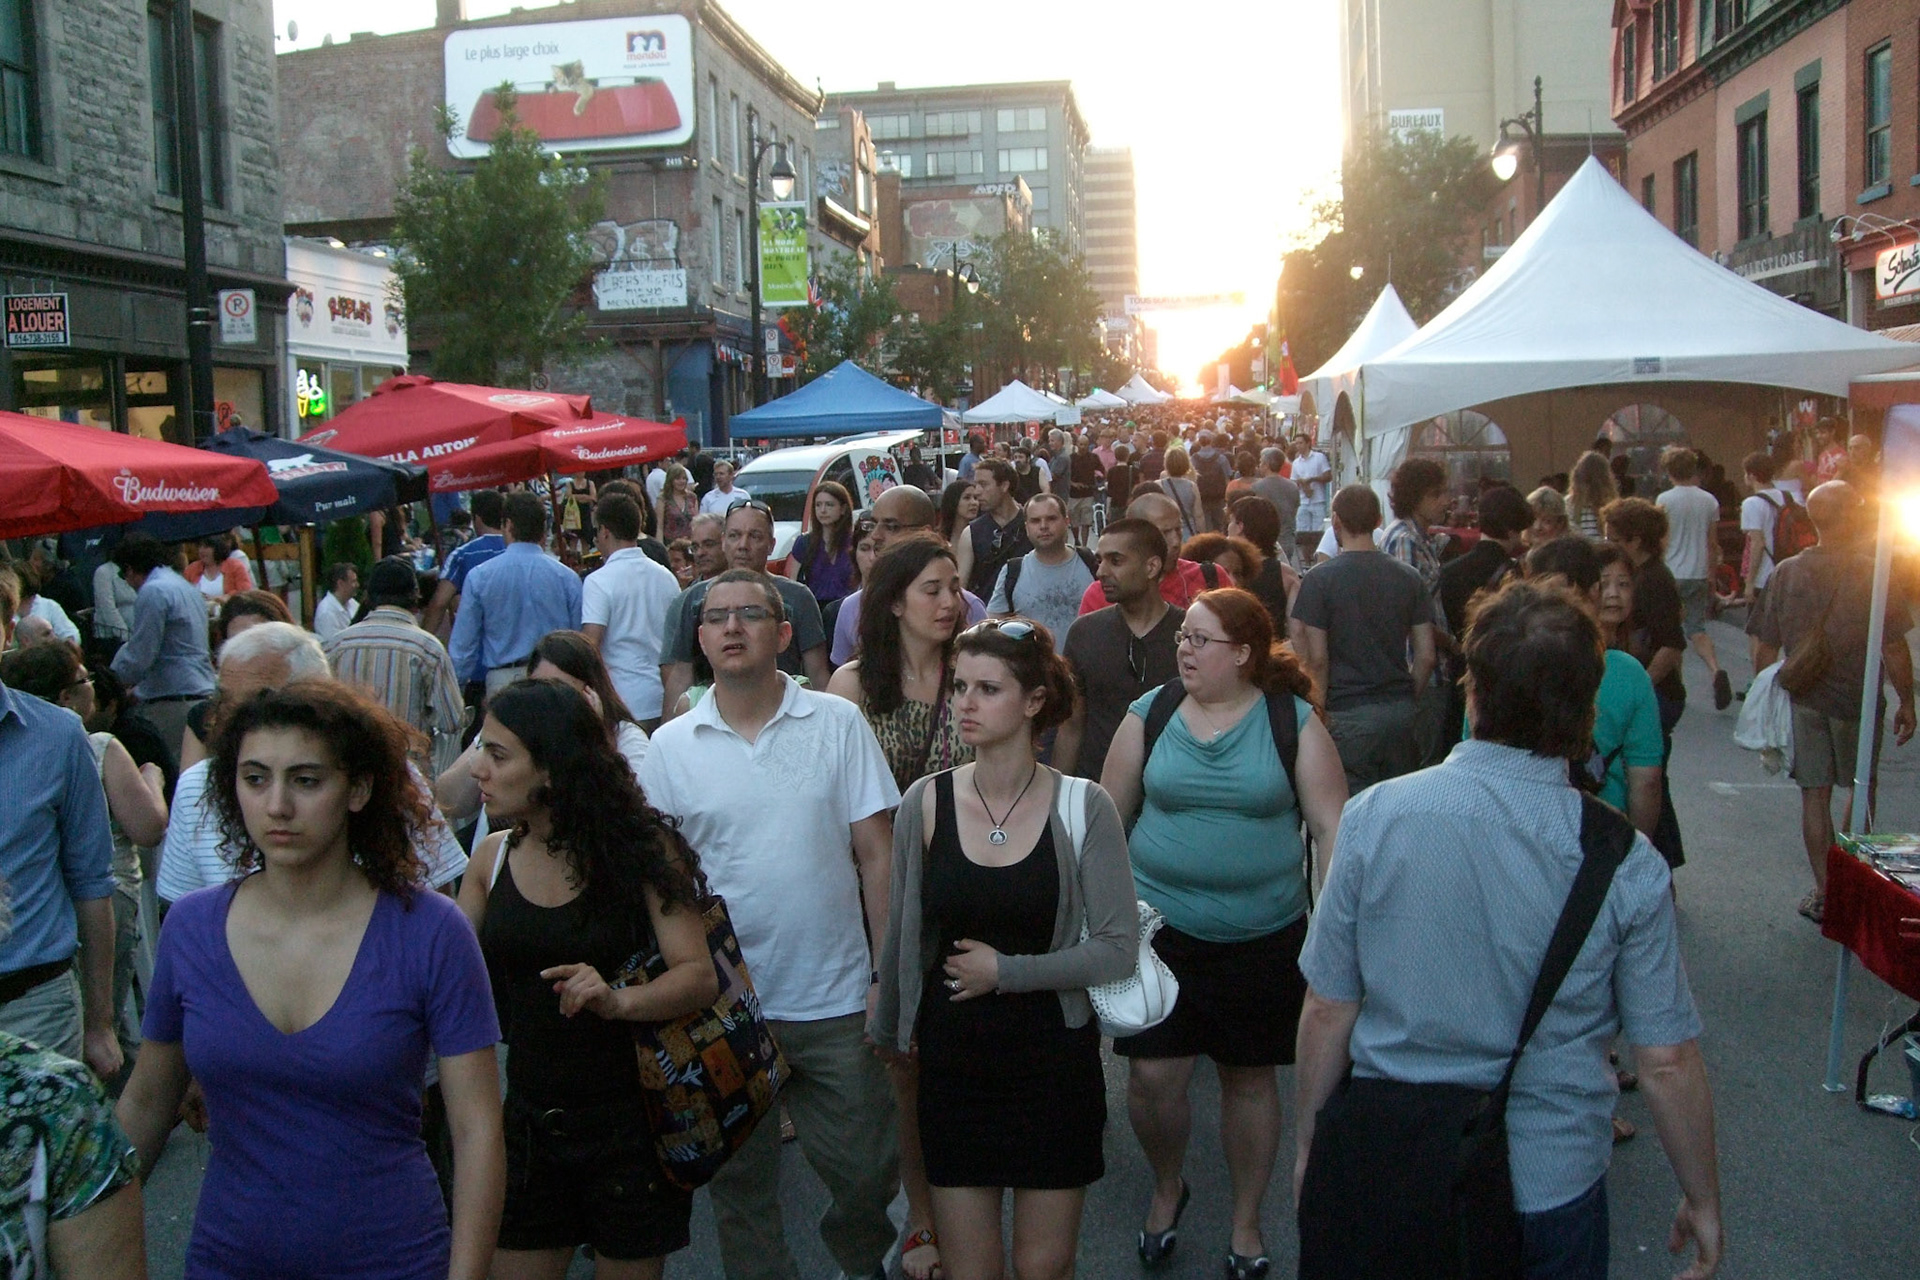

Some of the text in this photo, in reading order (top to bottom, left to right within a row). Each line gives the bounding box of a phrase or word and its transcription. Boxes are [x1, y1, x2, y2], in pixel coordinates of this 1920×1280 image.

[464, 41, 560, 62] Le plus large choix
[1391, 114, 1441, 128] BUREAUX
[8, 297, 61, 311] LOGEMENT
[1129, 297, 1152, 305] TOUS
[20, 311, 65, 332] LOUER
[947, 430, 954, 440] 5
[1029, 426, 1036, 437] 5
[571, 444, 648, 461] Budweiser
[113, 475, 221, 505] Budweiser
[314, 495, 357, 512] Pur malt
